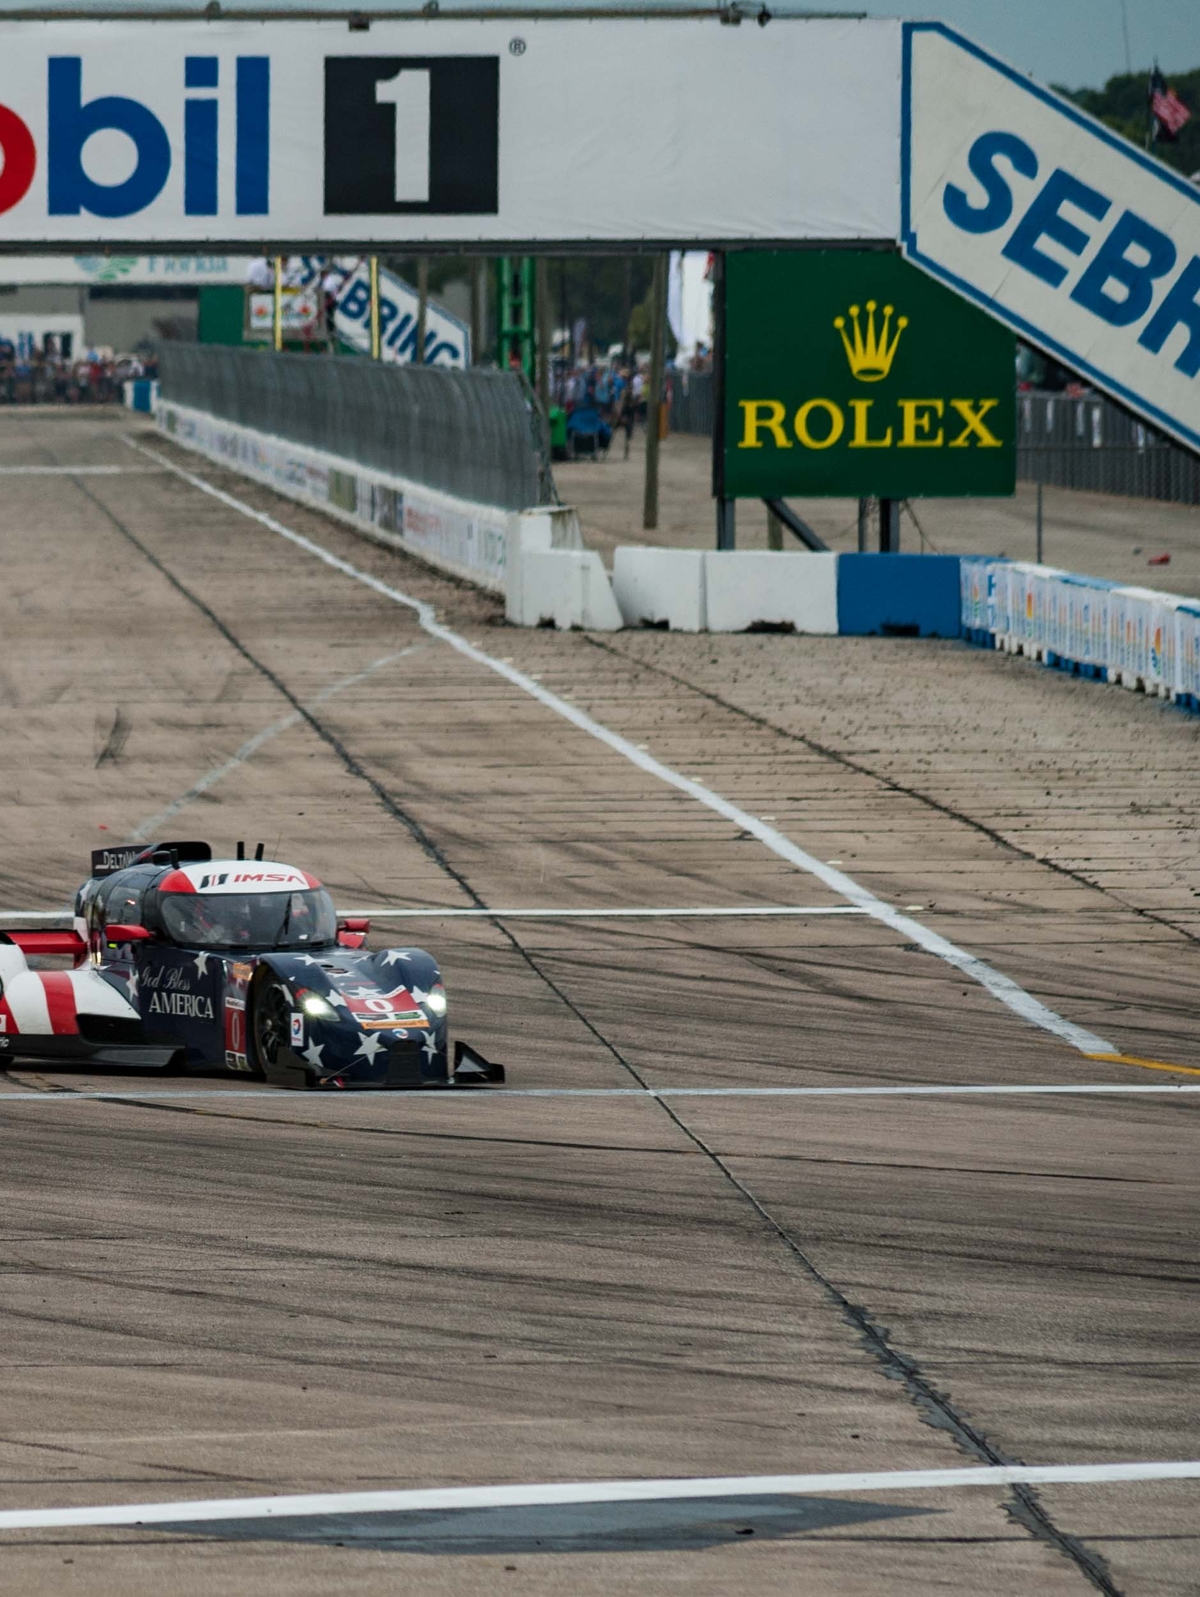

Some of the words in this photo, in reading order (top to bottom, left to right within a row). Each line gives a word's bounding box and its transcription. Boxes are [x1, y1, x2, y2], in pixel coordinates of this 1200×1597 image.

[375, 68, 430, 203] 1
[737, 398, 1003, 449] ROLEX
[148, 991, 215, 1019] AMERICA
